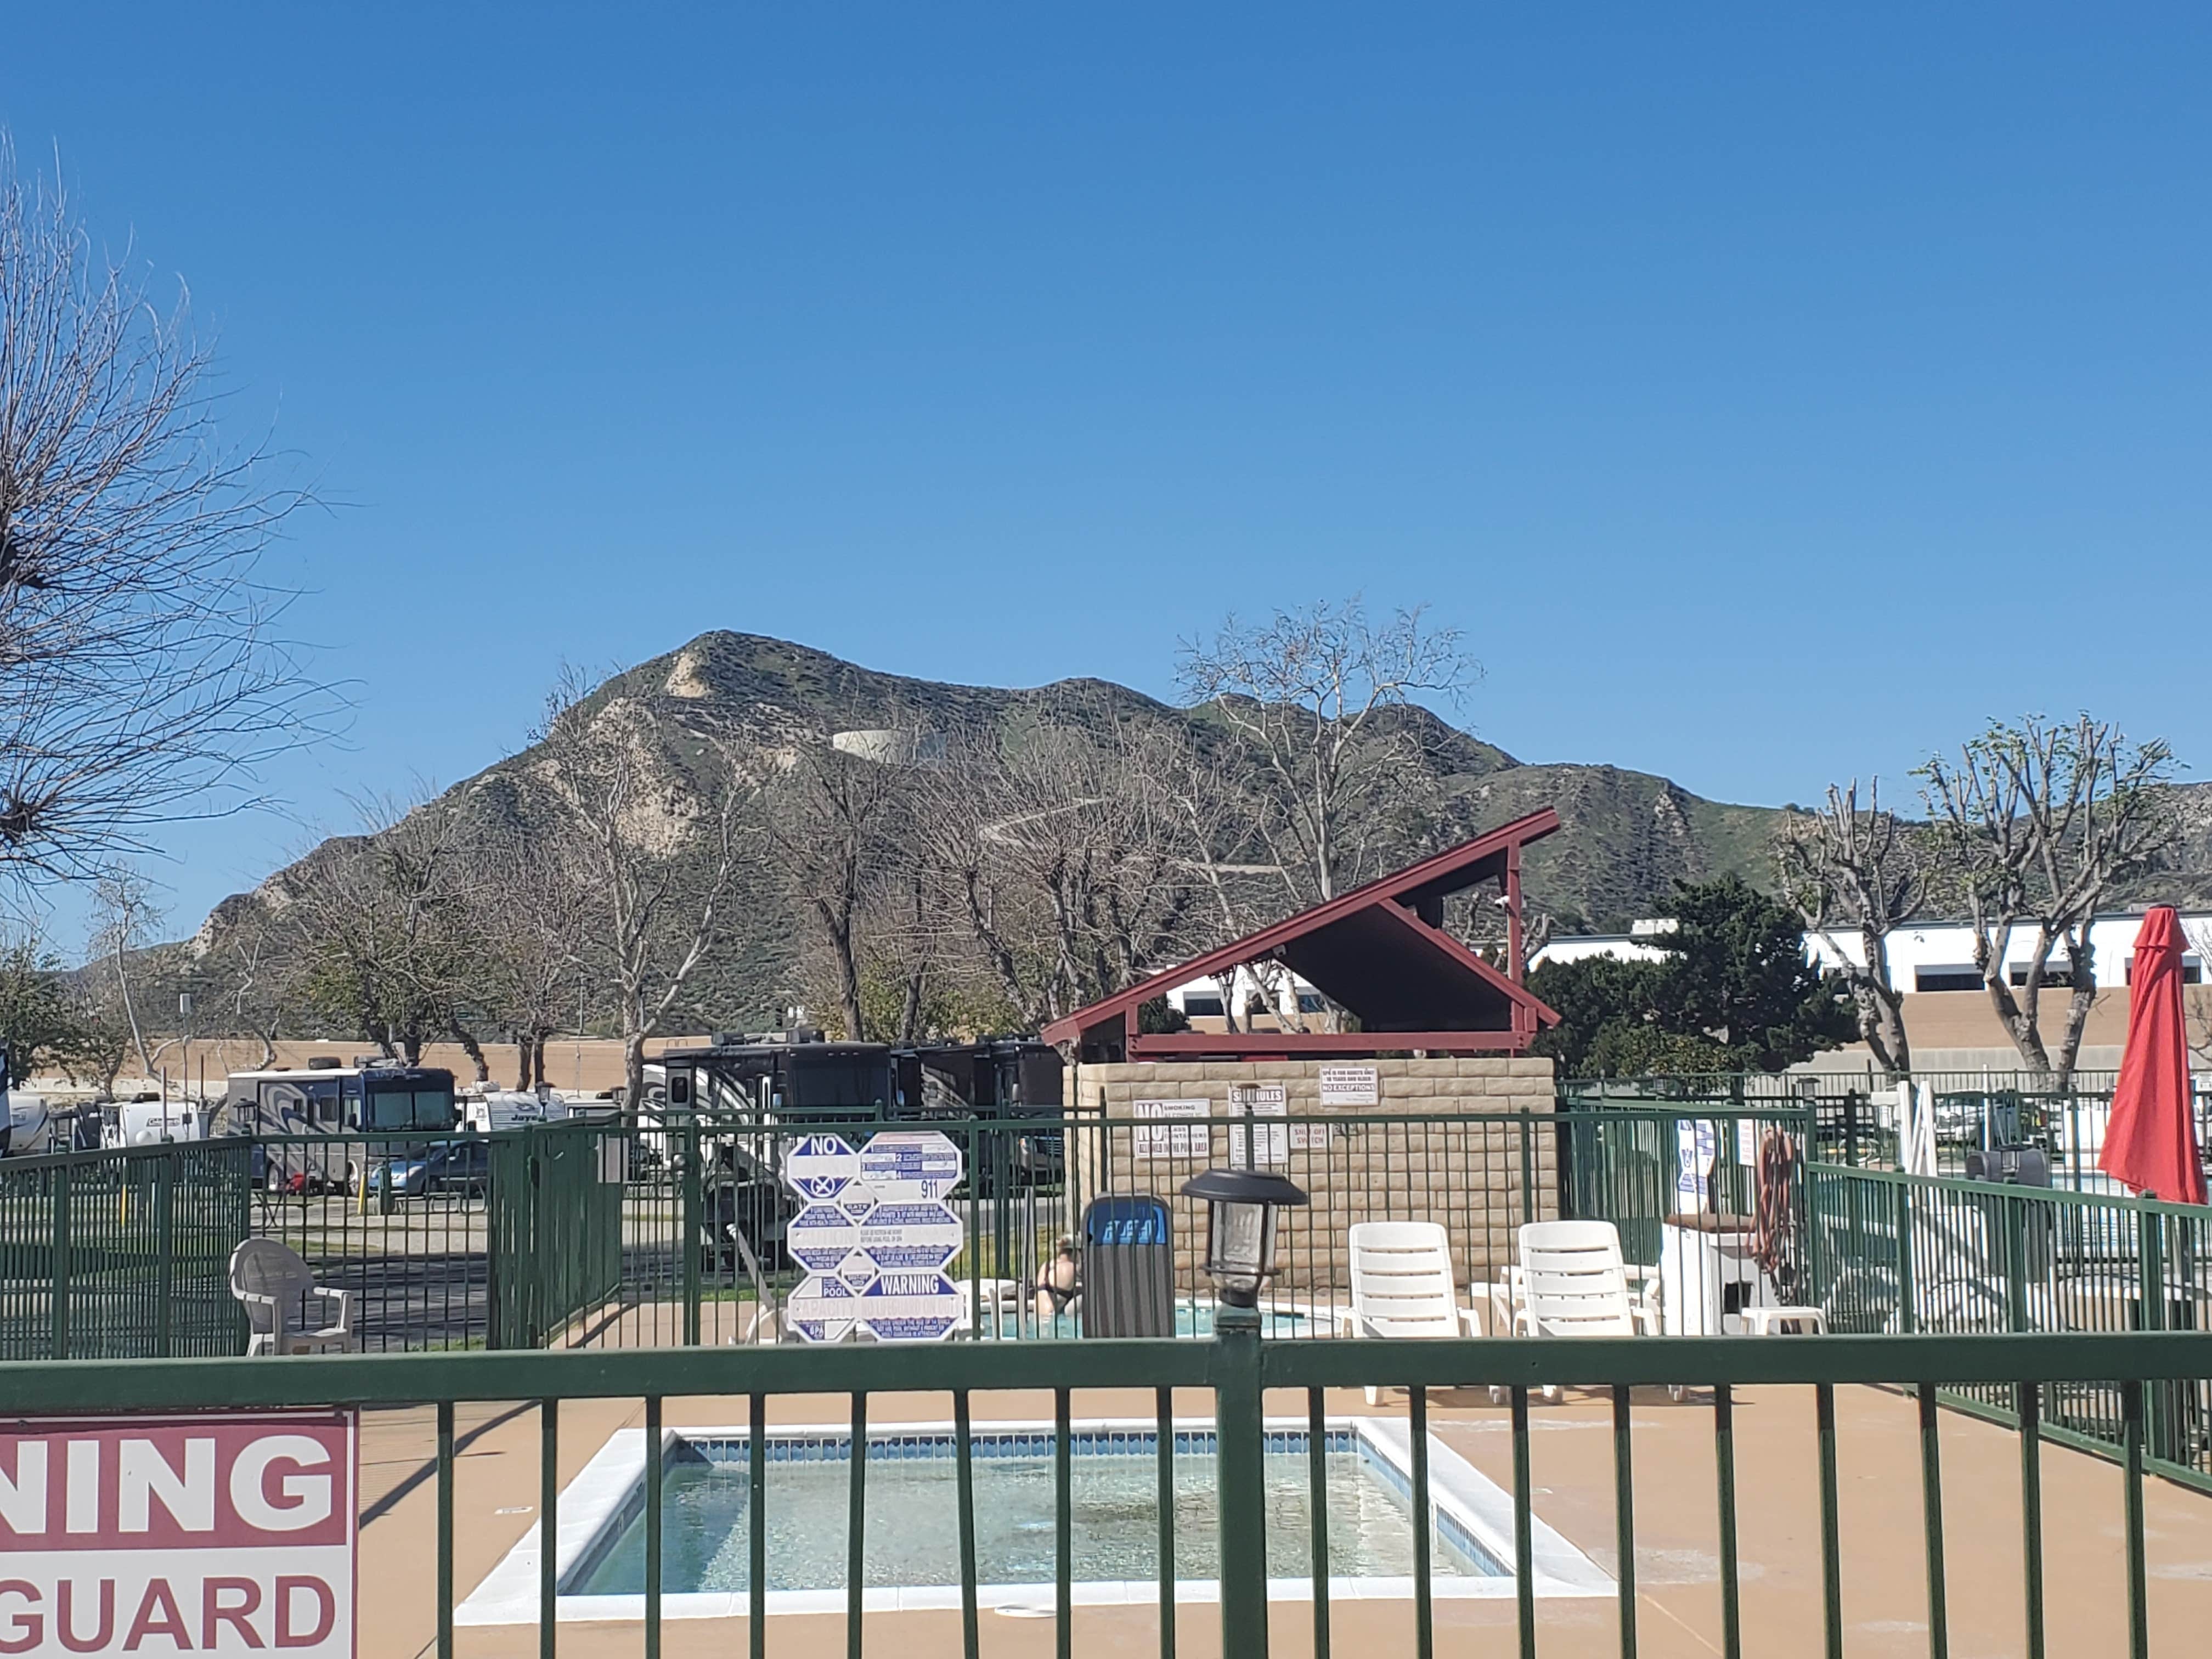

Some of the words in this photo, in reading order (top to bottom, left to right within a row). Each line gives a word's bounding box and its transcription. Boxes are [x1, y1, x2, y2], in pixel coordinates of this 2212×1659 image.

[1138, 1103, 1163, 1141] NO
[811, 1136, 837, 1155] NO
[896, 1154, 902, 1162] 2
[921, 1178, 939, 1199] 911
[823, 1287, 848, 1297] POOL
[880, 1274, 939, 1295] WARNING
[792, 1299, 855, 1318] CAPACITY
[0, 1575, 336, 1654] GUARD
